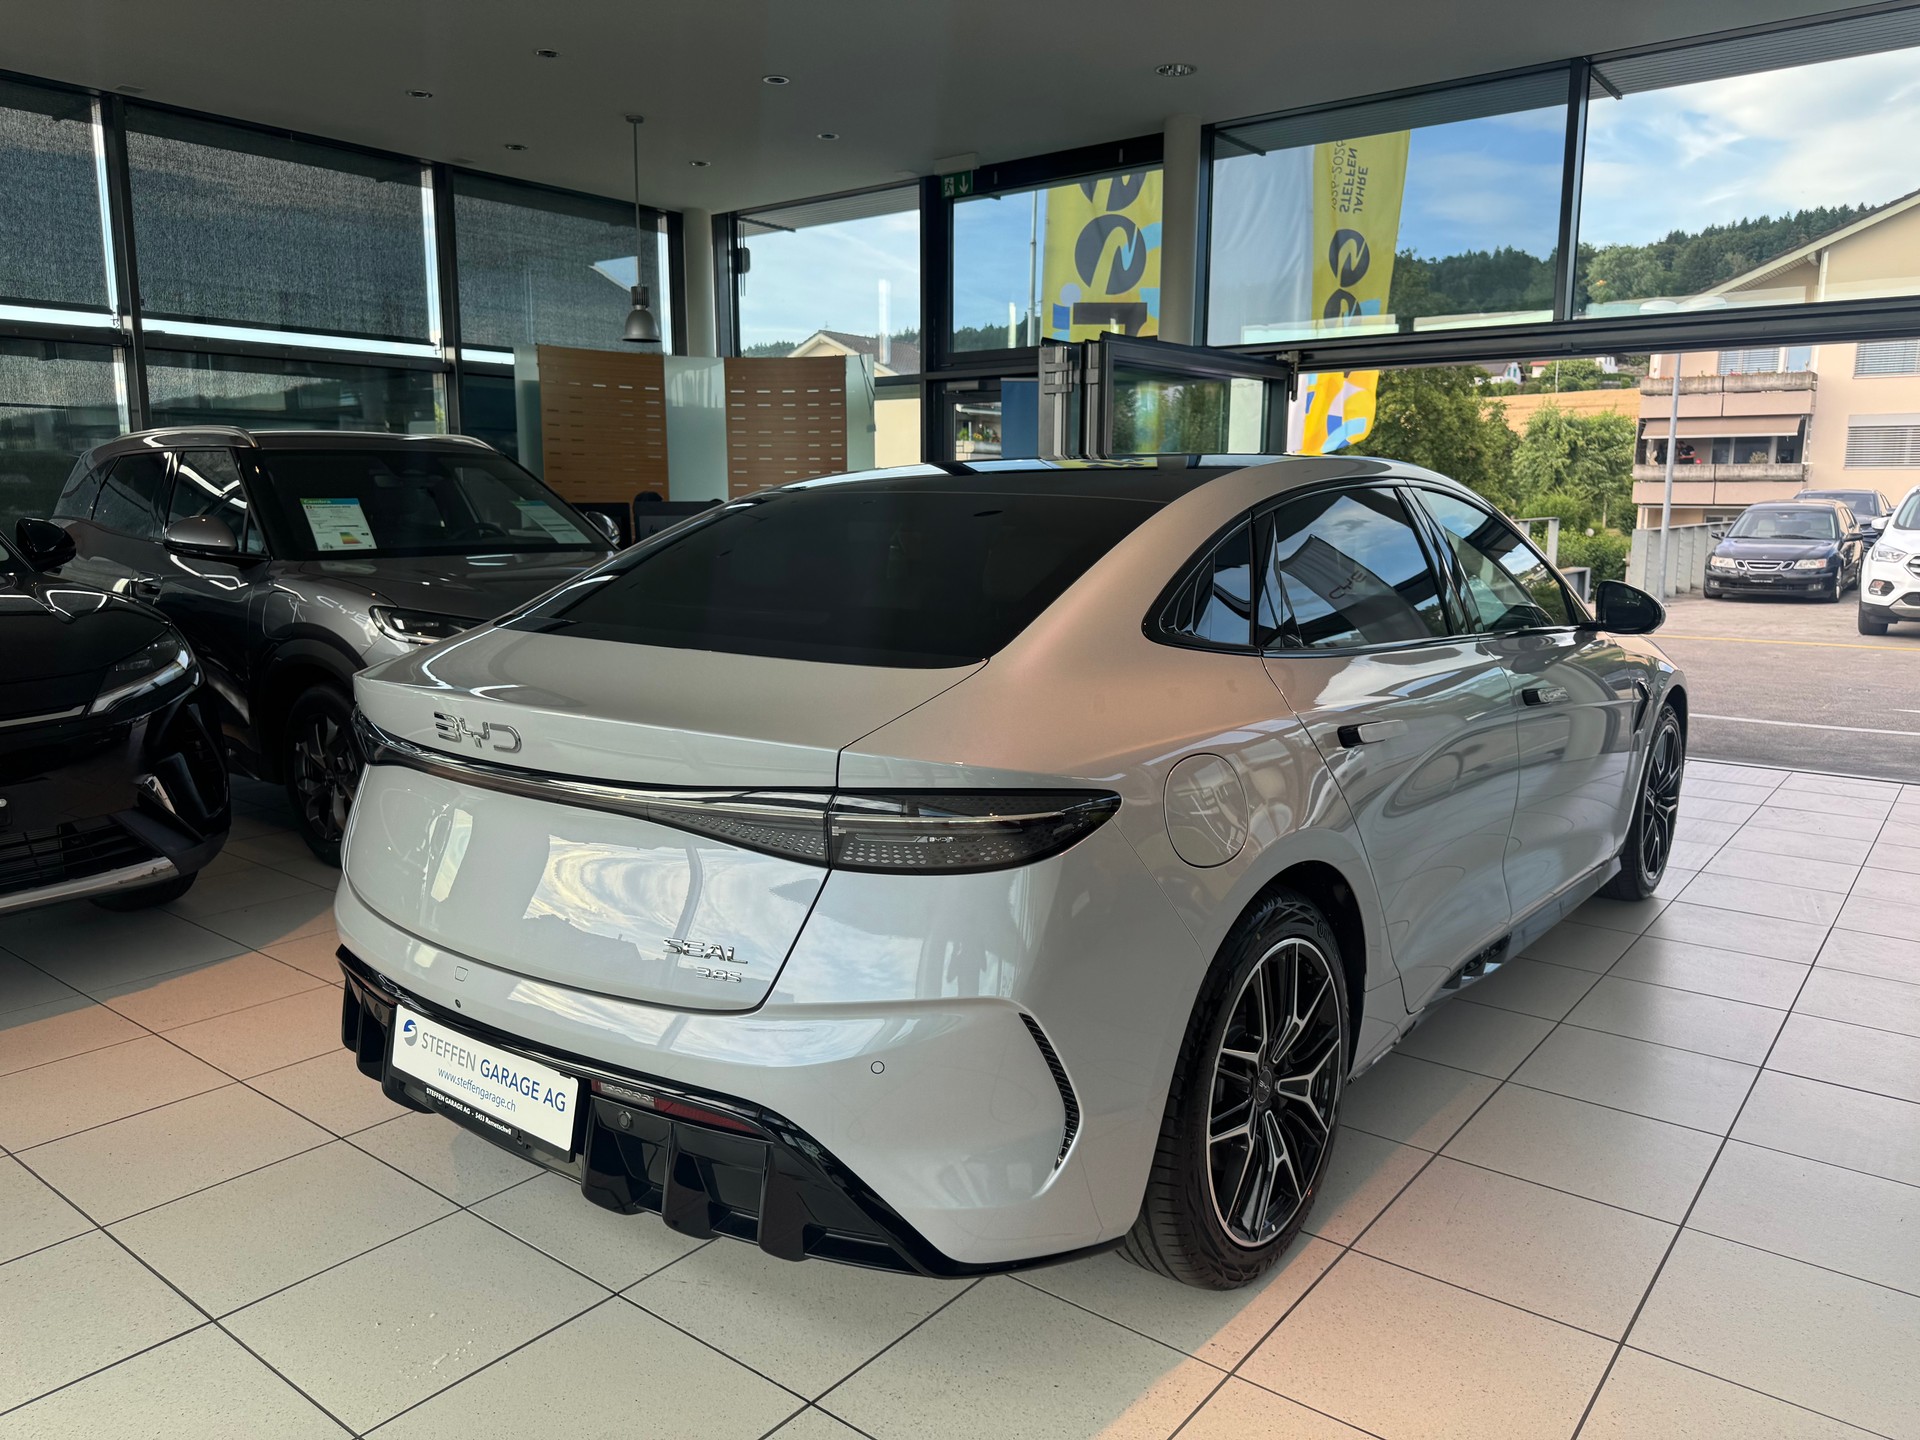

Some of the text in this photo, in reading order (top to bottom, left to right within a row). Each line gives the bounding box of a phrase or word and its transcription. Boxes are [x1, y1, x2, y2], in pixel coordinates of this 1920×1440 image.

[434, 711, 523, 754] BYD
[663, 937, 749, 964] SEAL
[421, 1031, 567, 1112] STEFFEN GARAGE AG
[437, 1067, 516, 1112] www.steffengarage.ch
[426, 1087, 445, 1102] STEFFEN
[445, 1097, 463, 1112] GARAGE
[463, 1106, 471, 1115] AG
